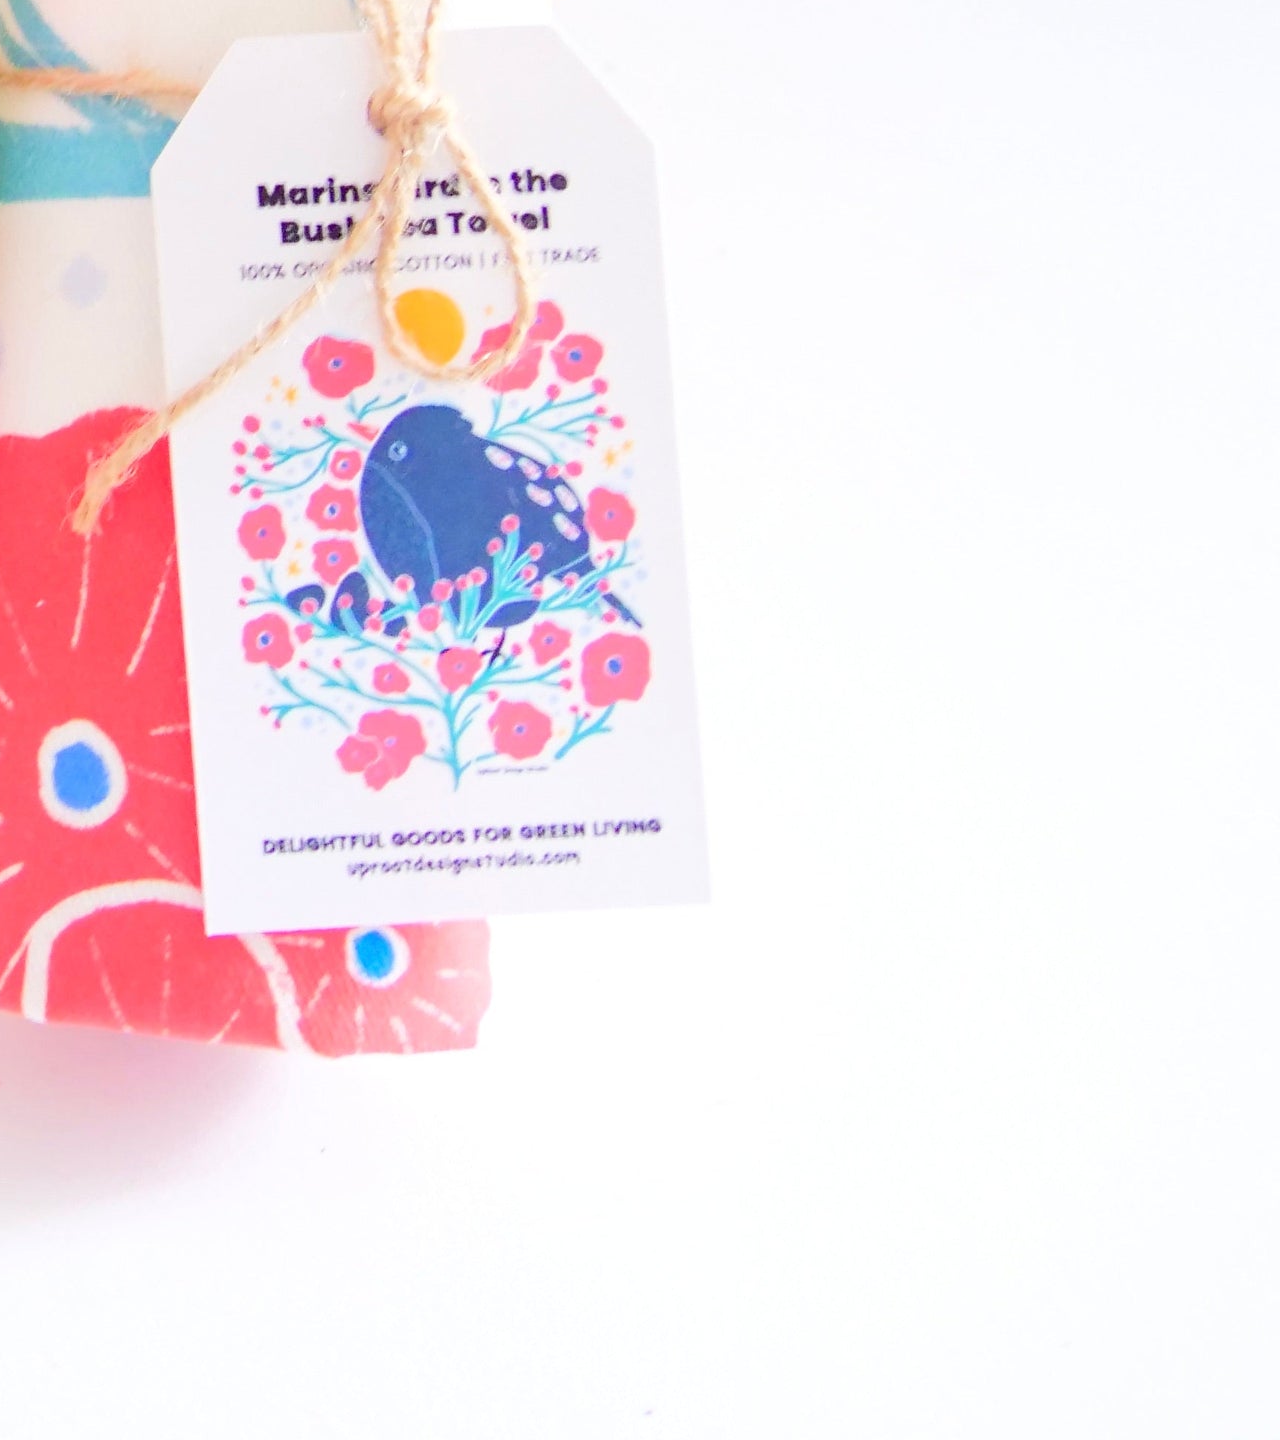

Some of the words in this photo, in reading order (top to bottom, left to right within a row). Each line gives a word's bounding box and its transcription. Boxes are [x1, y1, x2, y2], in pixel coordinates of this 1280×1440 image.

[510, 169, 568, 193] the
[446, 206, 550, 234] Toel
[542, 246, 602, 265] TRADE
[263, 832, 385, 855] DELIGHTFUL
[392, 828, 466, 847] GOODS
[474, 825, 513, 843] FOR
[519, 822, 586, 841] GREEN
[592, 817, 662, 837] LIVING
